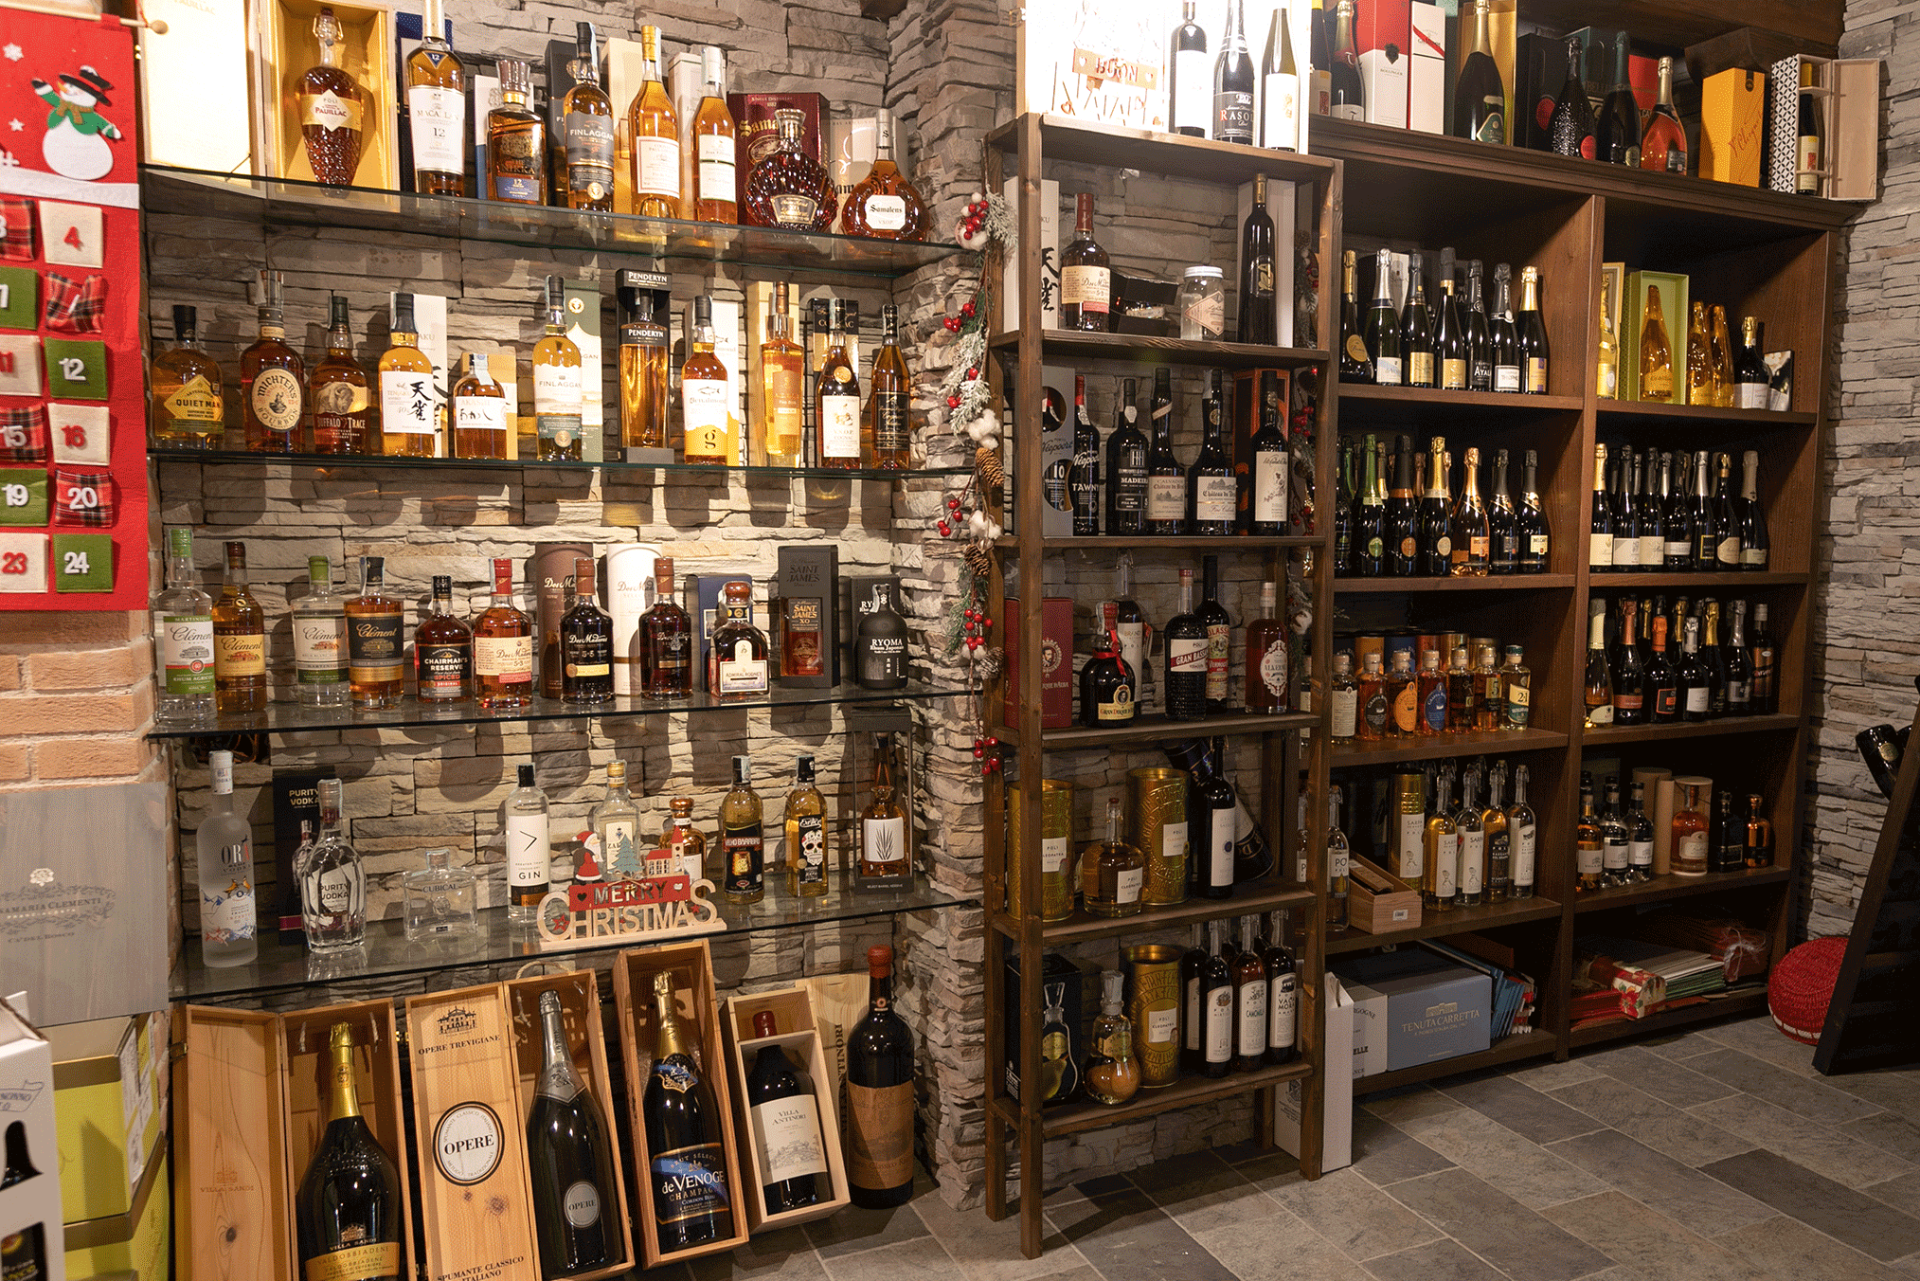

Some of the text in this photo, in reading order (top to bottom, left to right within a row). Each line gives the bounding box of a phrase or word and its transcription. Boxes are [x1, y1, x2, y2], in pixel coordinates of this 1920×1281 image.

[314, 107, 347, 118] PAUILLAC
[432, 127, 446, 138] 12
[570, 128, 614, 141] FINLAGGAN
[738, 118, 807, 138] Samas
[869, 203, 903, 213] Samalens
[63, 226, 81, 249] 4
[628, 271, 668, 283] PENDERYN
[818, 319, 854, 329] COAC
[628, 328, 664, 338] PENDERYN
[58, 358, 87, 381] 12
[1474, 365, 1491, 377] AYAL
[257, 375, 298, 398] MICHTER'S
[176, 398, 204, 407] QUIET
[257, 408, 299, 427] BOURBON
[347, 416, 366, 430] TRACE
[0, 425, 27, 448] 15
[61, 424, 86, 448] 16
[1053, 464, 1065, 479] 10
[1, 484, 29, 507] 19
[67, 487, 98, 510] 20
[1, 552, 28, 575] 23
[63, 551, 90, 575] 24
[789, 564, 819, 574] SAINT
[786, 574, 820, 583] JAMES
[793, 604, 817, 612] SAINT
[792, 611, 818, 619] JAMES
[303, 626, 344, 641] Clément
[356, 623, 397, 638] Clément
[221, 636, 262, 651] Clément
[871, 638, 903, 647] RYOMA
[424, 656, 468, 665] CHAIRMAN'S
[1175, 652, 1193, 666] GRAN
[289, 788, 319, 798] PURITY
[289, 797, 320, 807] VODKA
[518, 870, 541, 880] GIN
[320, 883, 349, 893] PURITY
[422, 883, 458, 893] CUBICAL
[593, 880, 668, 905] MERRY
[320, 891, 349, 901] VODKA
[47, 897, 102, 910] CLEMENTI
[536, 878, 718, 942] CHRISTMAS
[1401, 1009, 1480, 1033] TENUTA CARRETTA
[418, 1034, 501, 1056] OPERE TREVIGIANE
[772, 1113, 807, 1126] ANTINORI
[444, 1133, 495, 1156] OPERE
[568, 1198, 597, 1212] OPERE
[329, 1243, 351, 1252] VILLA
[436, 1255, 524, 1281] SPUMANTE CLASSICO
